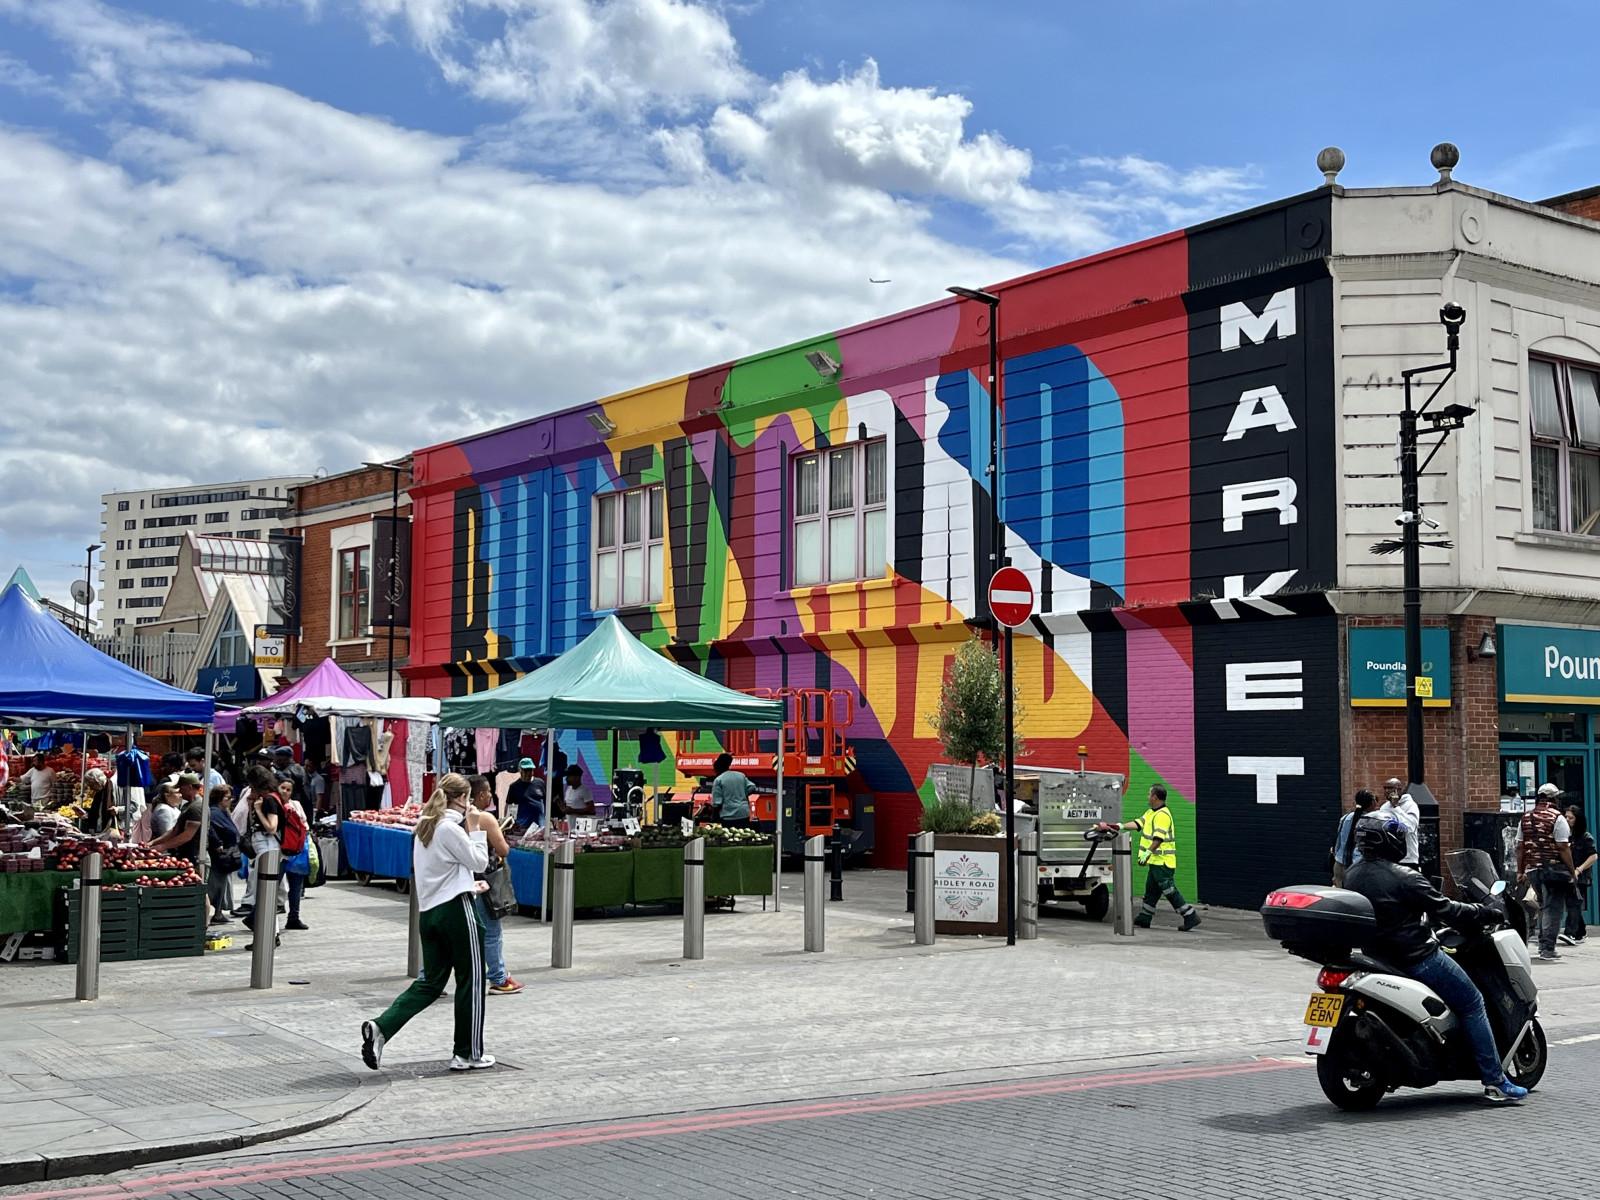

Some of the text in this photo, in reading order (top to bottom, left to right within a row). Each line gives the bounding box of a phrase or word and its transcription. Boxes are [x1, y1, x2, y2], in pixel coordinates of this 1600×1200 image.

[1210, 287, 1305, 804] MARKET
[279, 553, 297, 617] Kingsland
[262, 646, 279, 656] TO
[1366, 661, 1407, 671] Poundla
[1544, 645, 1600, 680] Poun
[211, 677, 238, 698] Kingsland
[934, 879, 966, 887] RIDLEY
[1310, 996, 1342, 1010] PE70
[1310, 1009, 1335, 1022] EBN
[1307, 1027, 1322, 1046] L
